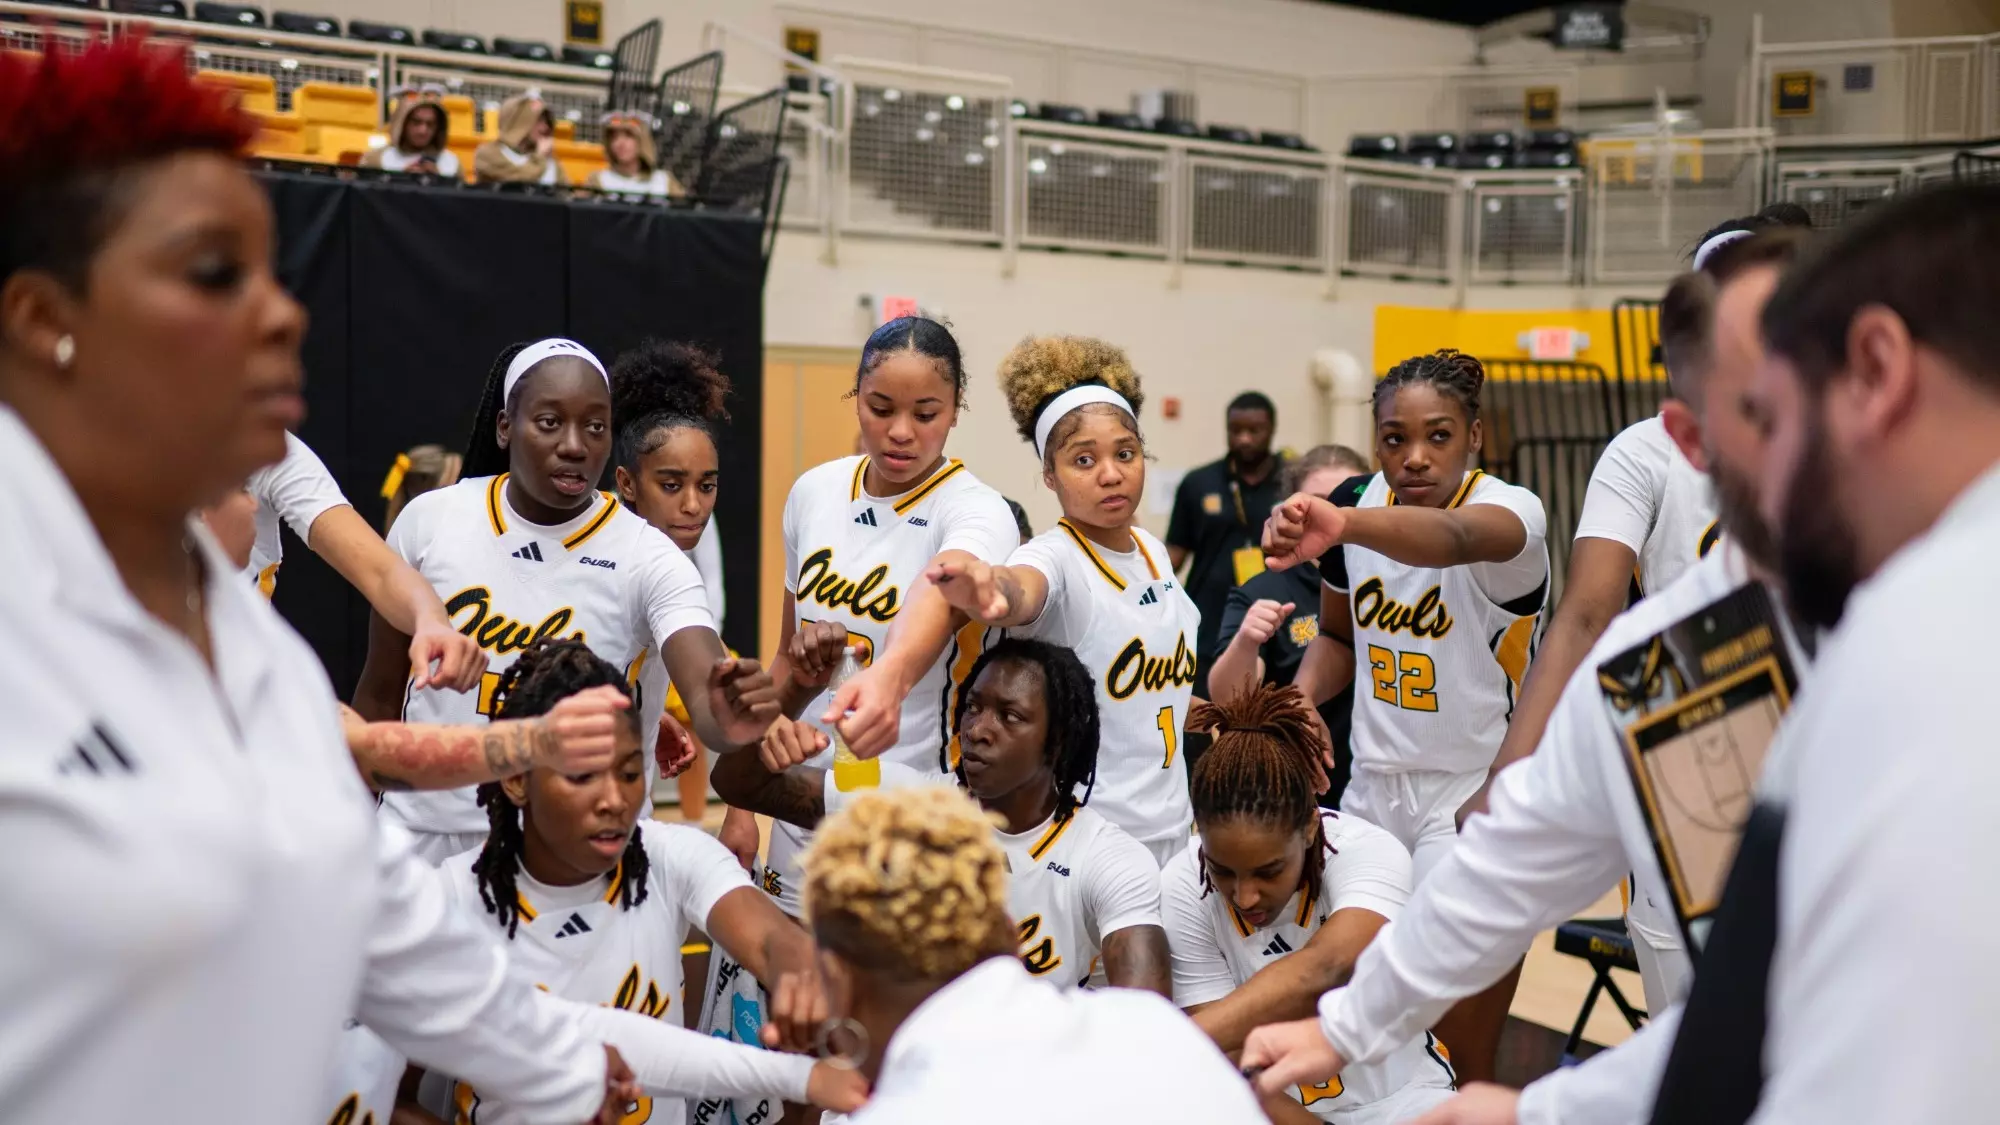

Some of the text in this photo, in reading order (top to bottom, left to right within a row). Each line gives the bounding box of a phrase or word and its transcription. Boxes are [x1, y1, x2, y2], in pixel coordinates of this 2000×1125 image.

[444, 584, 586, 655] Owl
[796, 546, 901, 624] Owls
[1354, 576, 1453, 640] Owls
[1106, 629, 1197, 701] Owls
[1368, 643, 1439, 712] 22
[1156, 705, 1177, 769] 1
